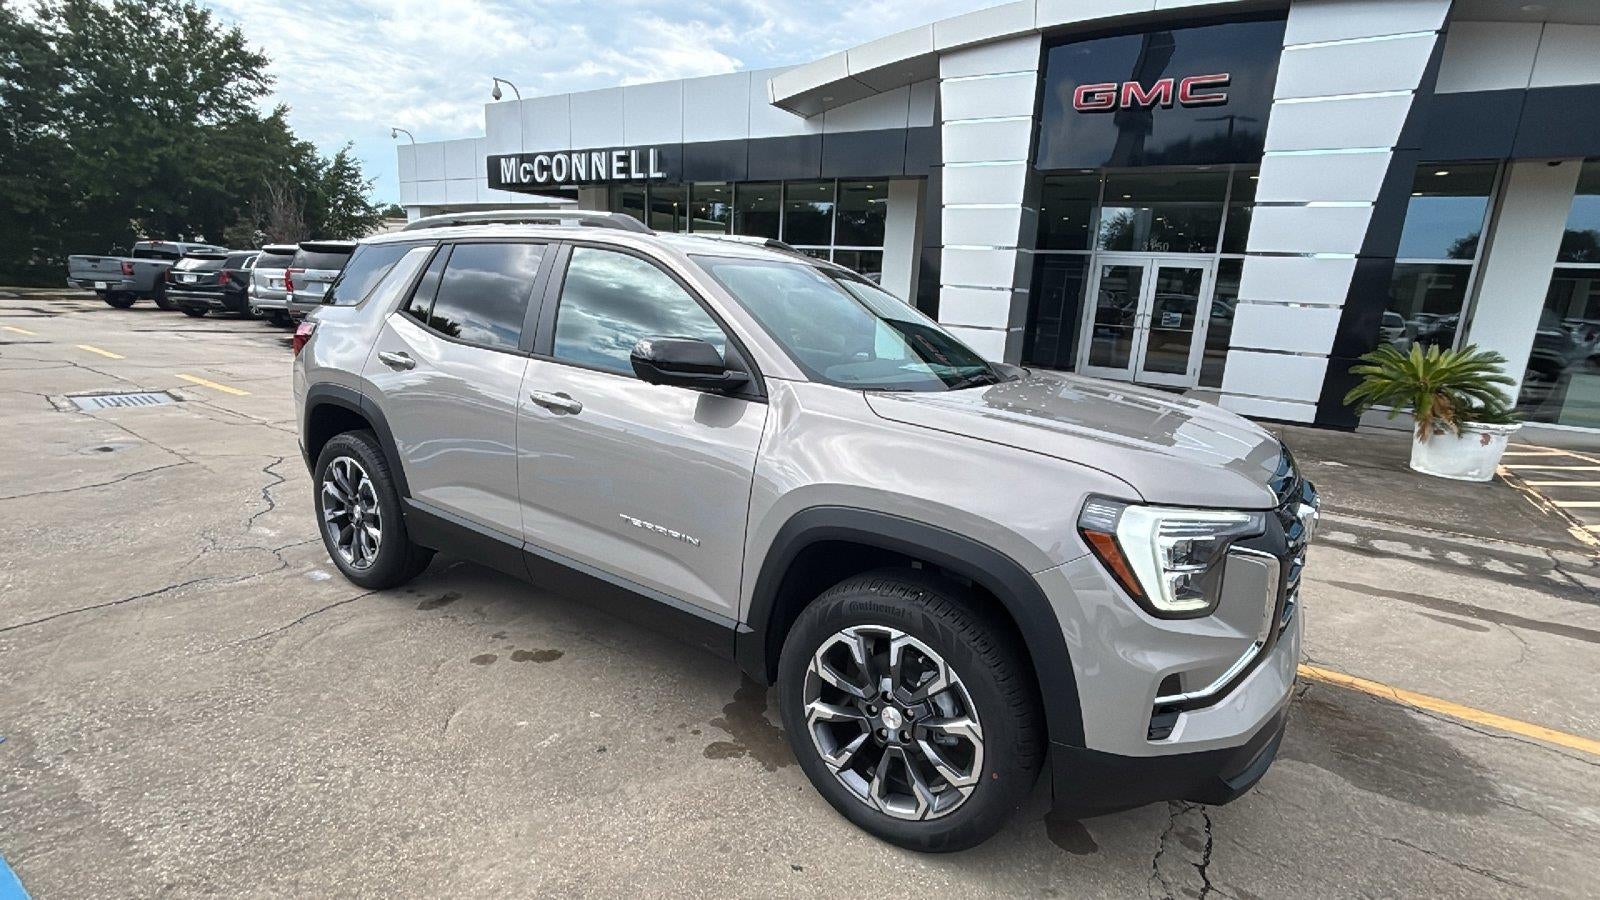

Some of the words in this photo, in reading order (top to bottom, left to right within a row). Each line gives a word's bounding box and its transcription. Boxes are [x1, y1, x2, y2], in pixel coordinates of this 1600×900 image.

[1073, 73, 1230, 111] GMC
[500, 148, 666, 184] McCONNELL
[619, 513, 701, 547] TERRAIN
